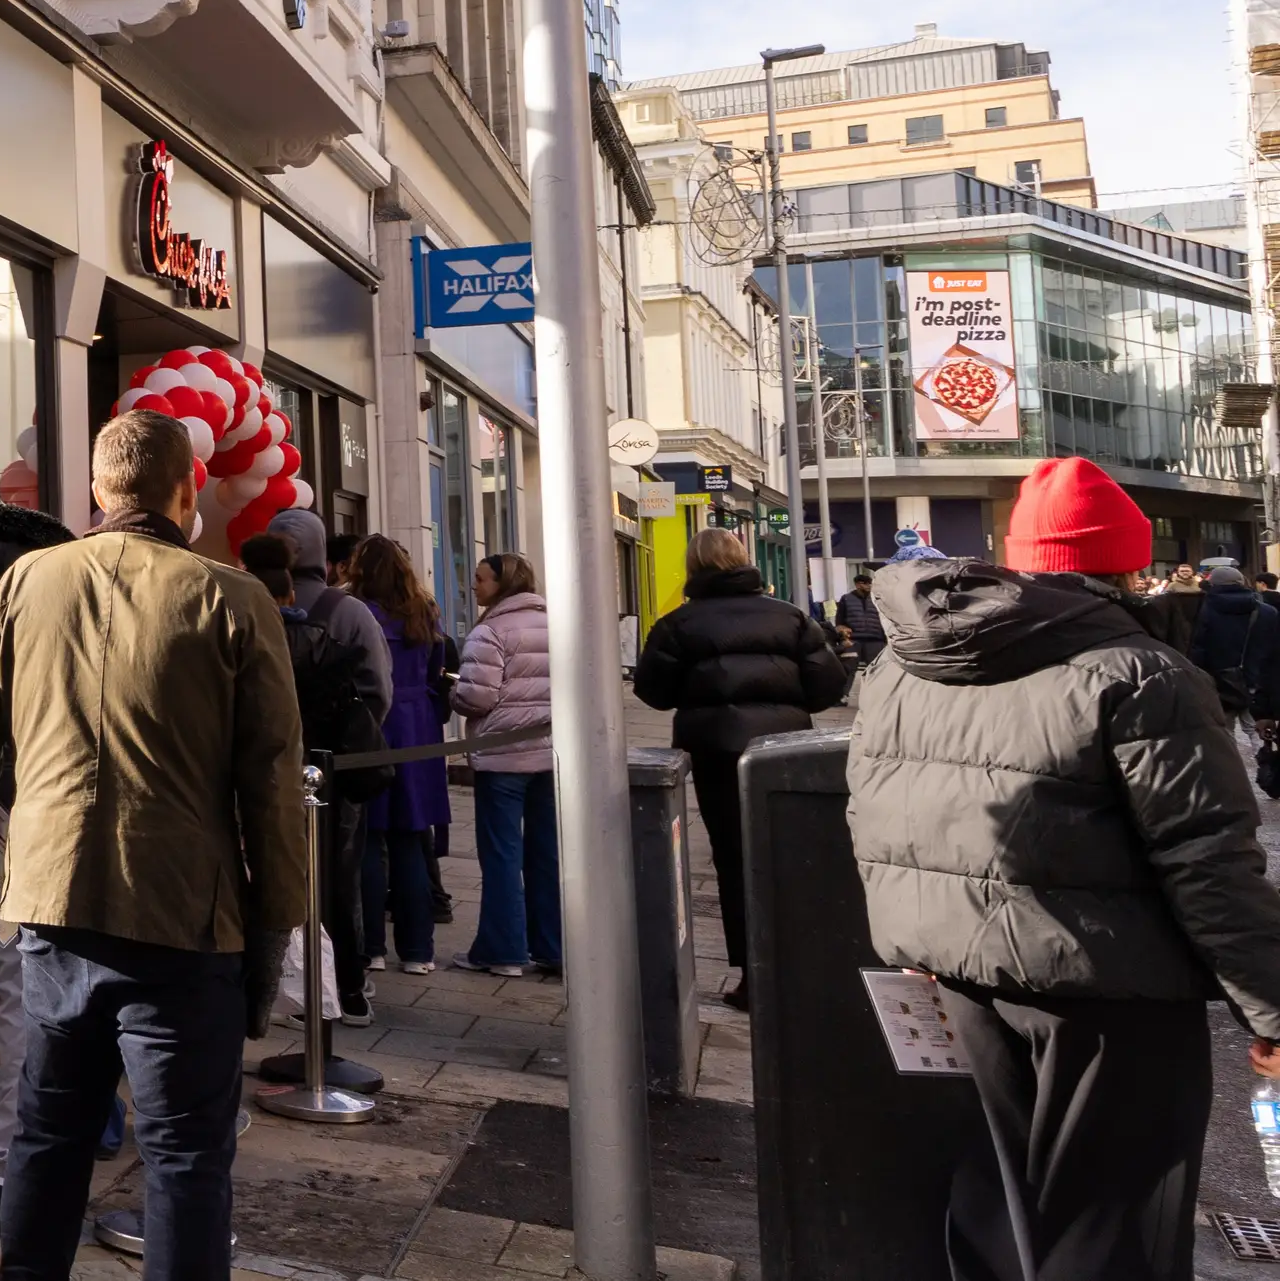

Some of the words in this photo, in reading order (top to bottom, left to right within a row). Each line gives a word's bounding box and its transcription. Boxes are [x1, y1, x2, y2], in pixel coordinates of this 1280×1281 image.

[443, 274, 533, 296] HALIFAX
[946, 280, 966, 288] JUST
[967, 279, 984, 287] EAT
[915, 297, 944, 311] i'm
[950, 298, 1001, 314] post-
[921, 312, 1002, 326] deadline
[956, 327, 1006, 345] pizza
[608, 432, 655, 452] Lovisa
